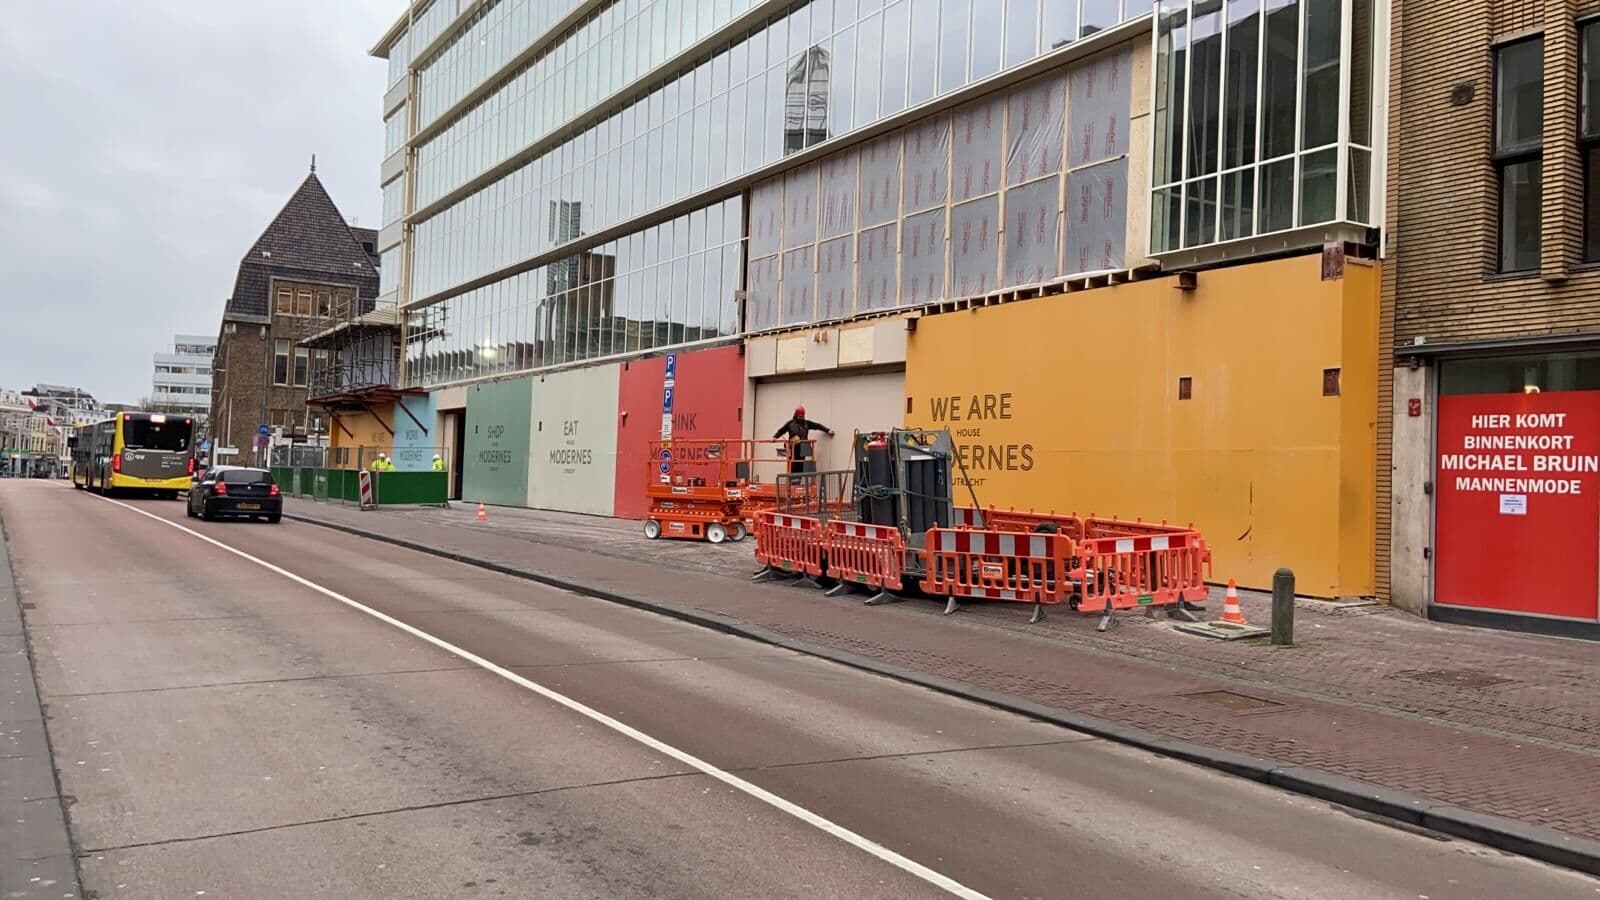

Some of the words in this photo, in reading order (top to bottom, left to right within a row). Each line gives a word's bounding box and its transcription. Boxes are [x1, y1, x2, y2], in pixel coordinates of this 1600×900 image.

[930, 397, 961, 422] WE
[967, 393, 1012, 420] ARE
[563, 420, 579, 436] EAT
[671, 412, 697, 431] HINK
[1471, 414, 1511, 428] HIER
[1516, 413, 1566, 428] KOMT
[487, 425, 504, 438] SHOP
[956, 428, 982, 437] HOUSE
[1464, 435, 1574, 449] BINNENKORT
[479, 450, 512, 463] MODERNES
[549, 449, 592, 465] MODERNES
[951, 444, 1034, 471] ERNES
[1441, 454, 1528, 471] MICHAEL
[1533, 455, 1599, 472] BRUIN
[1456, 477, 1582, 494] MANNENMODE
